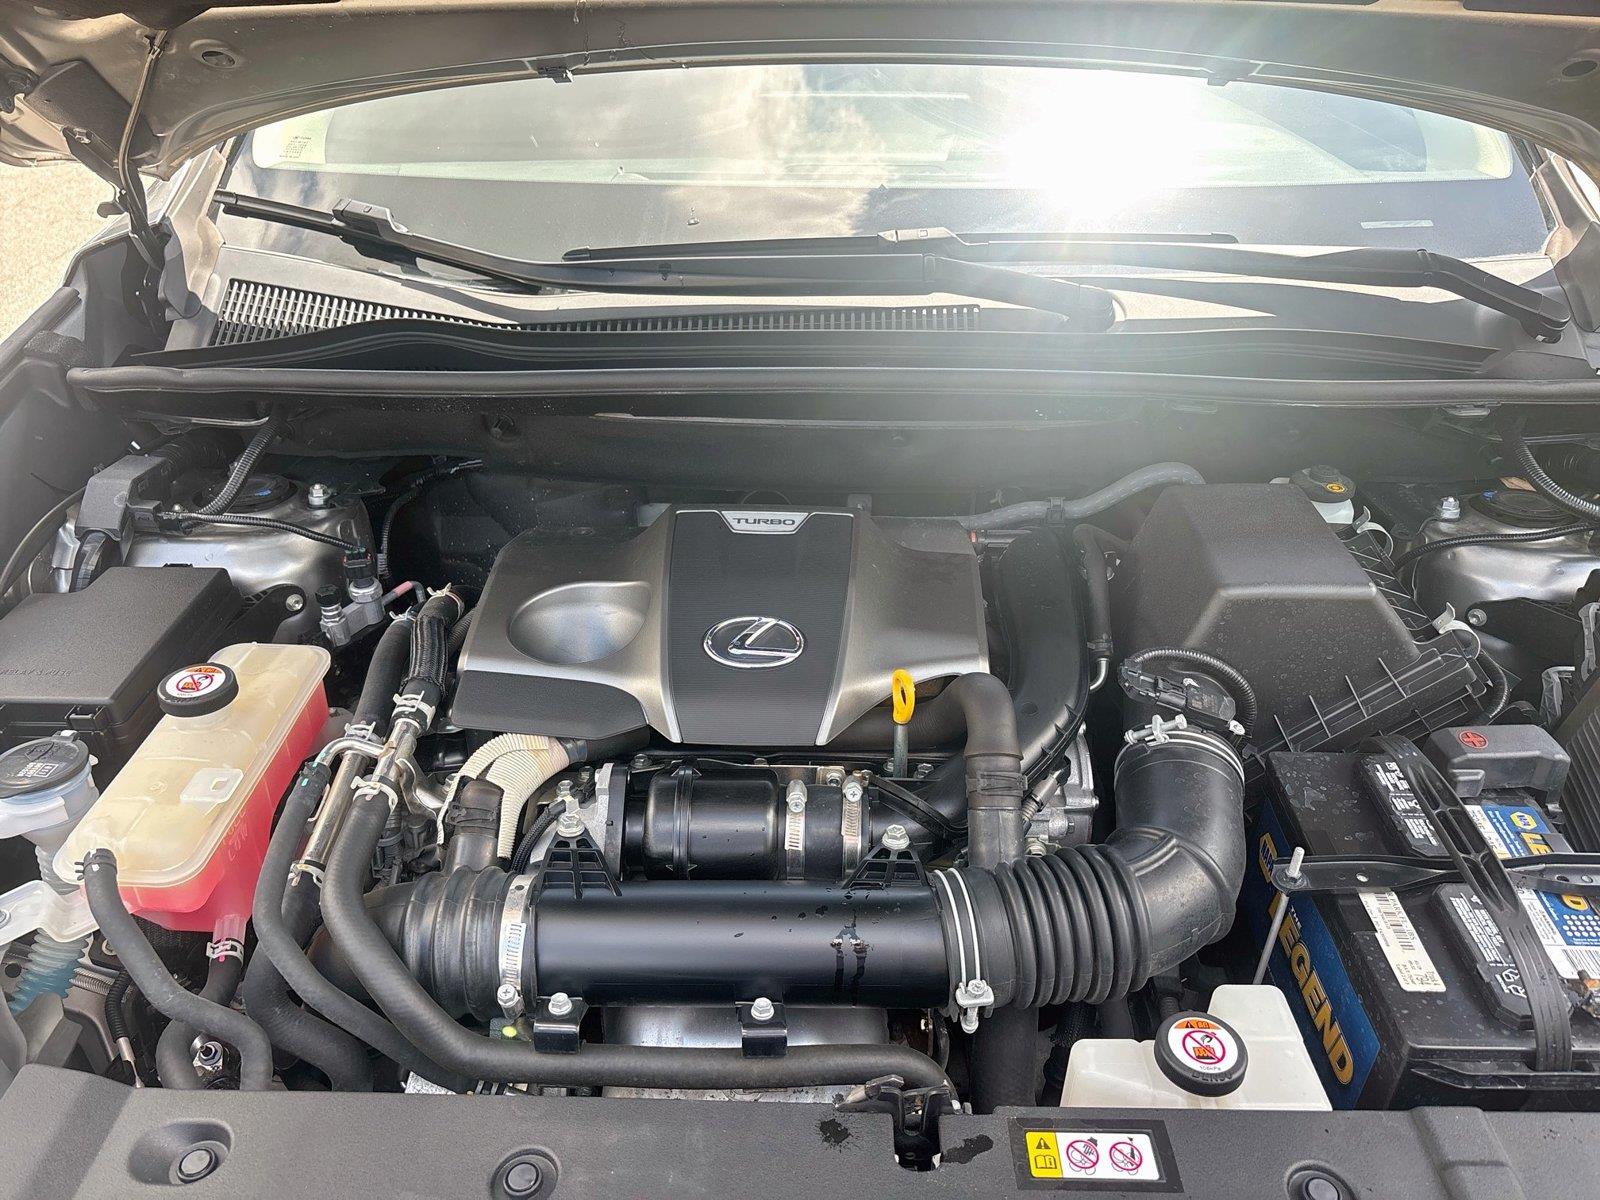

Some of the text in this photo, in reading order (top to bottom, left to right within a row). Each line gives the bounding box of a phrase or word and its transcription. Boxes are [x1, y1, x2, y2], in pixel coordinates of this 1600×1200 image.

[732, 517, 796, 526] TURBO
[1289, 905, 1302, 929] THE
[1268, 892, 1355, 1085] LEGEND
[1192, 1070, 1233, 1082] DENSO
